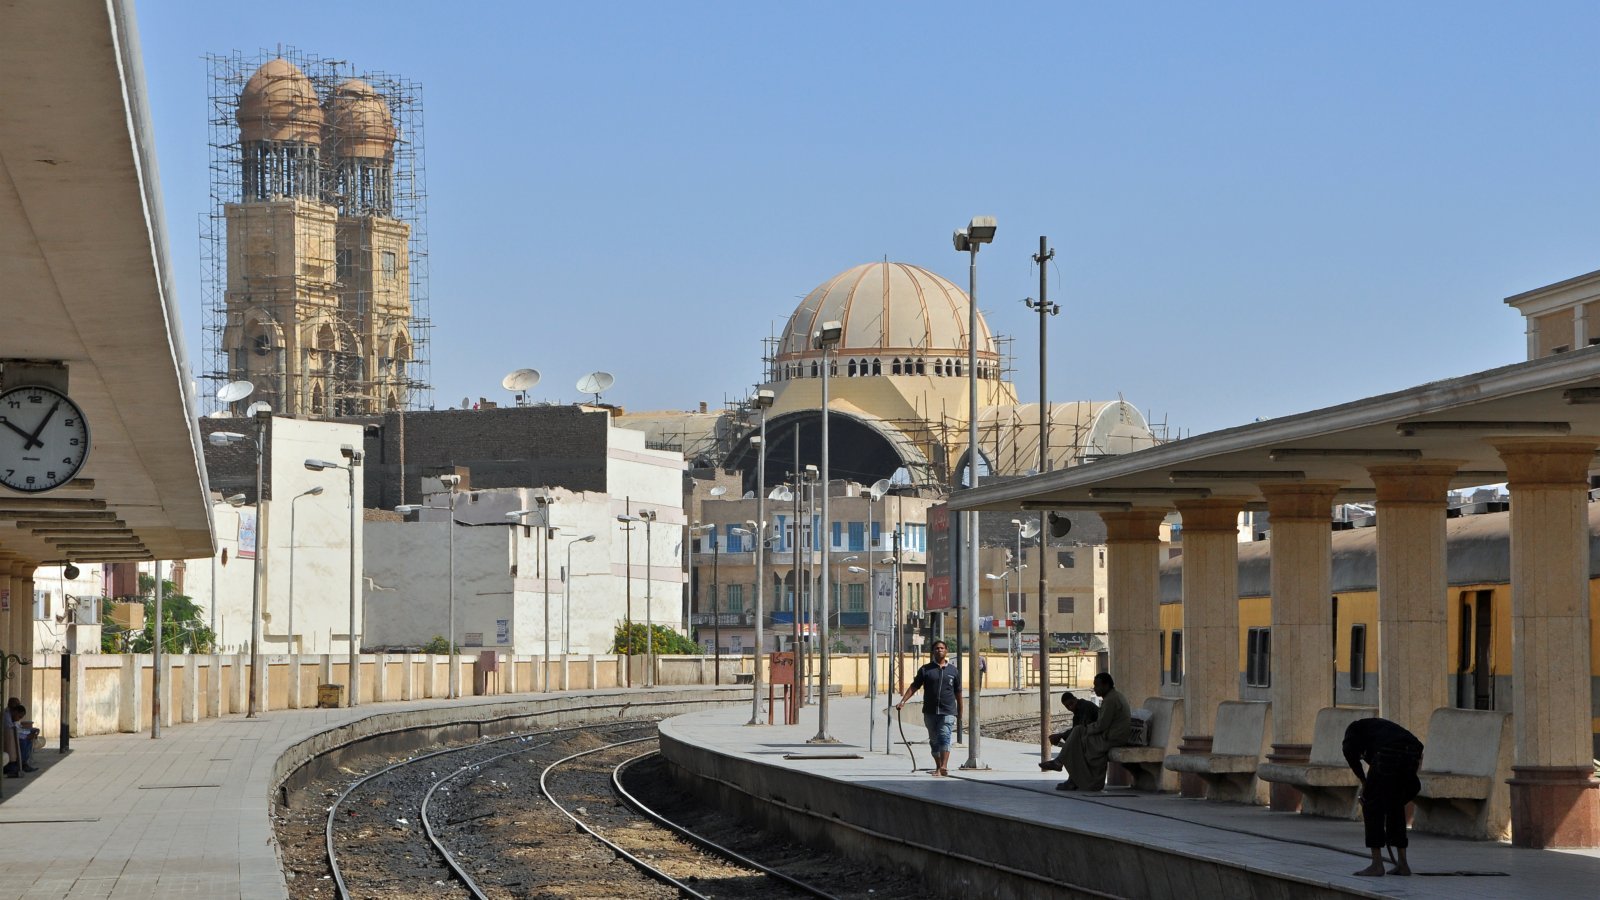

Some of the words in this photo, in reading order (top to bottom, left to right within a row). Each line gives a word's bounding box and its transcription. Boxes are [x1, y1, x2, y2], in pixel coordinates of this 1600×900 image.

[27, 395, 42, 404] 12
[8, 401, 20, 409] 11
[65, 419, 74, 427] 2
[70, 438, 79, 446] 3
[62, 457, 72, 465] 4
[6, 469, 15, 477] 7
[47, 471, 56, 479] 5
[26, 476, 35, 484] 6
